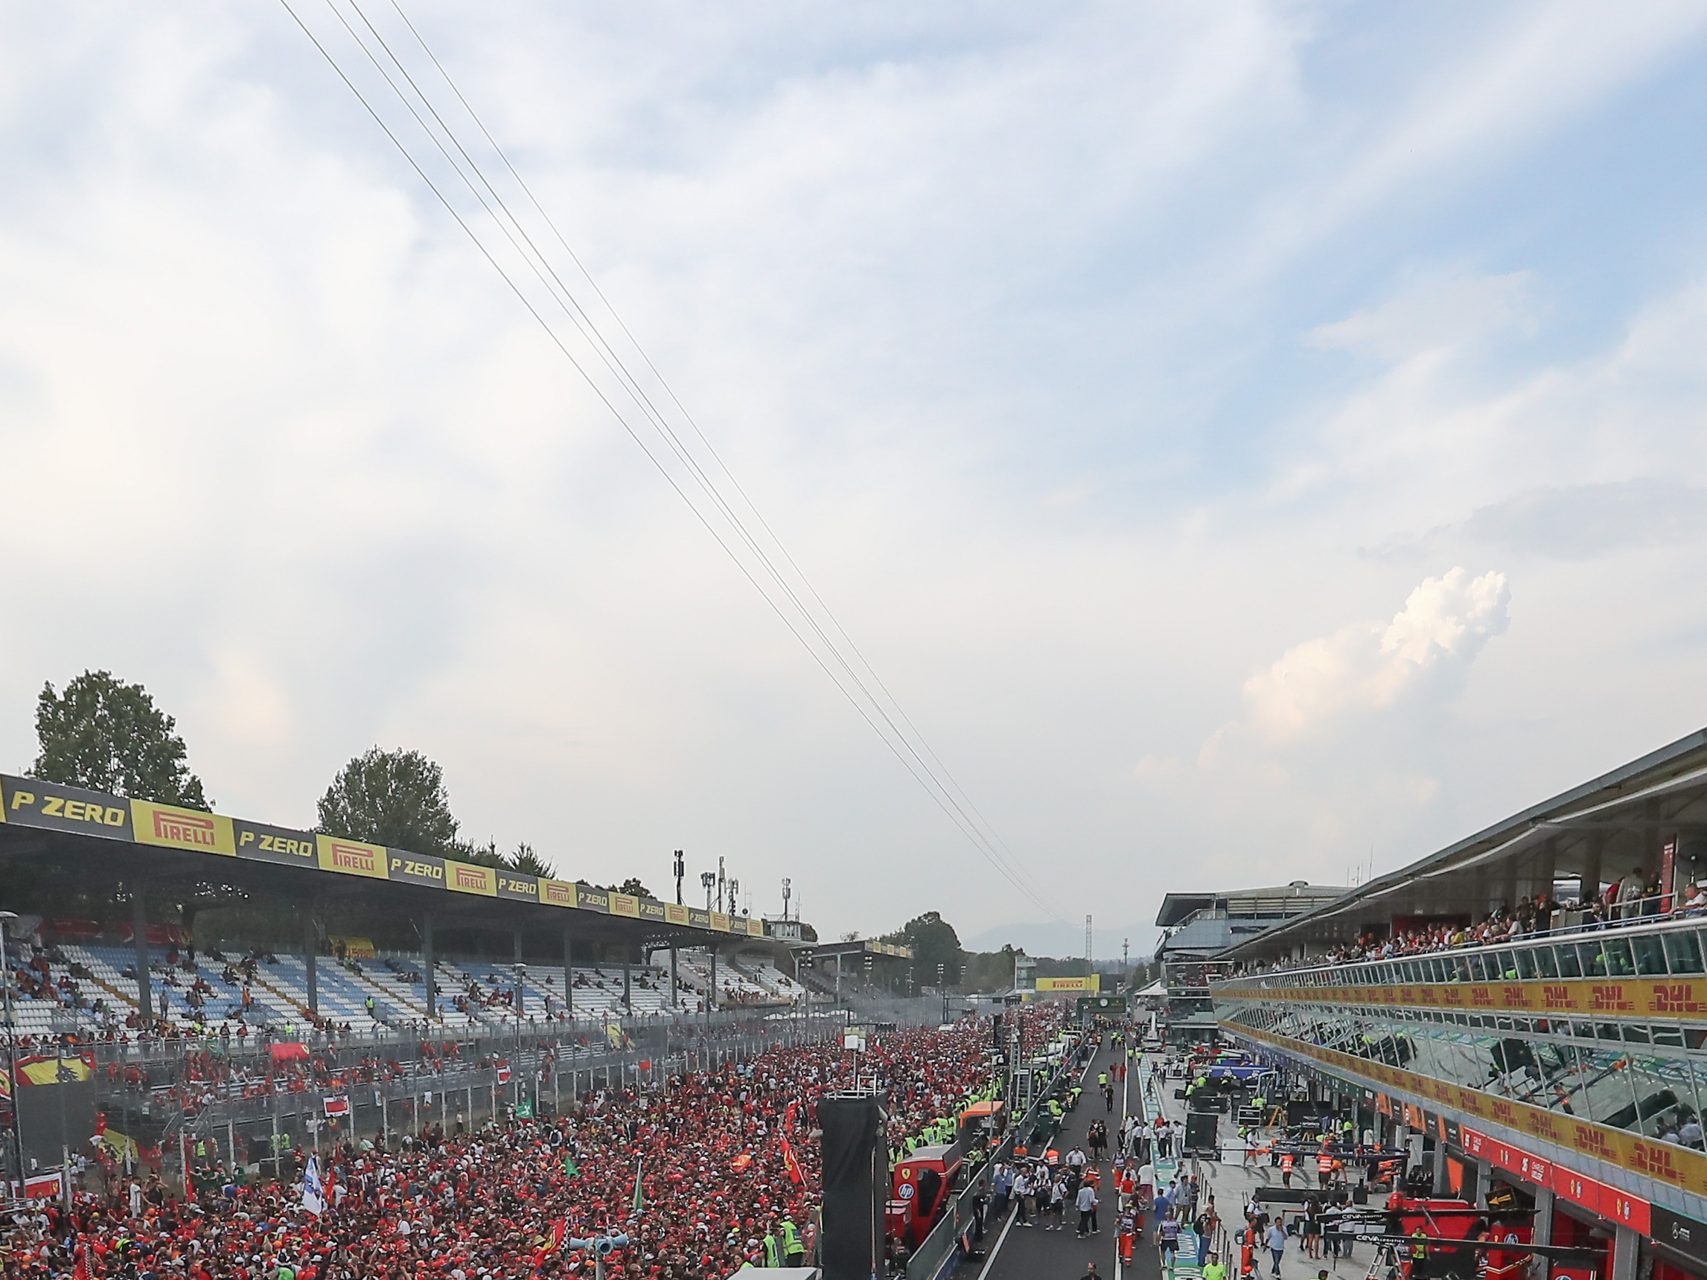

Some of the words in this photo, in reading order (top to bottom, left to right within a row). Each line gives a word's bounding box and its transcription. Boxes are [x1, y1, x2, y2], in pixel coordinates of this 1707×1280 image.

[11, 791, 36, 810] P
[41, 796, 125, 827] ZERO
[152, 809, 216, 846] PIRELLI
[239, 831, 255, 847] P
[258, 834, 313, 858] ZERO
[332, 843, 375, 871] PIRELLI
[390, 858, 401, 871] P
[404, 860, 443, 880] ZERO
[455, 867, 487, 890] PIRELLI
[498, 878, 506, 890] P
[507, 880, 537, 894] ZERO
[1504, 986, 1530, 1007] DHL
[1543, 985, 1574, 1010] DHL
[1592, 985, 1629, 1010] DHL
[1653, 984, 1700, 1013] DHL
[1492, 1101, 1516, 1126] DHL
[1530, 1112, 1557, 1139] DHL
[1575, 1126, 1609, 1156] DHL
[1634, 1142, 1678, 1179] DHL
[900, 1184, 912, 1199] hp
